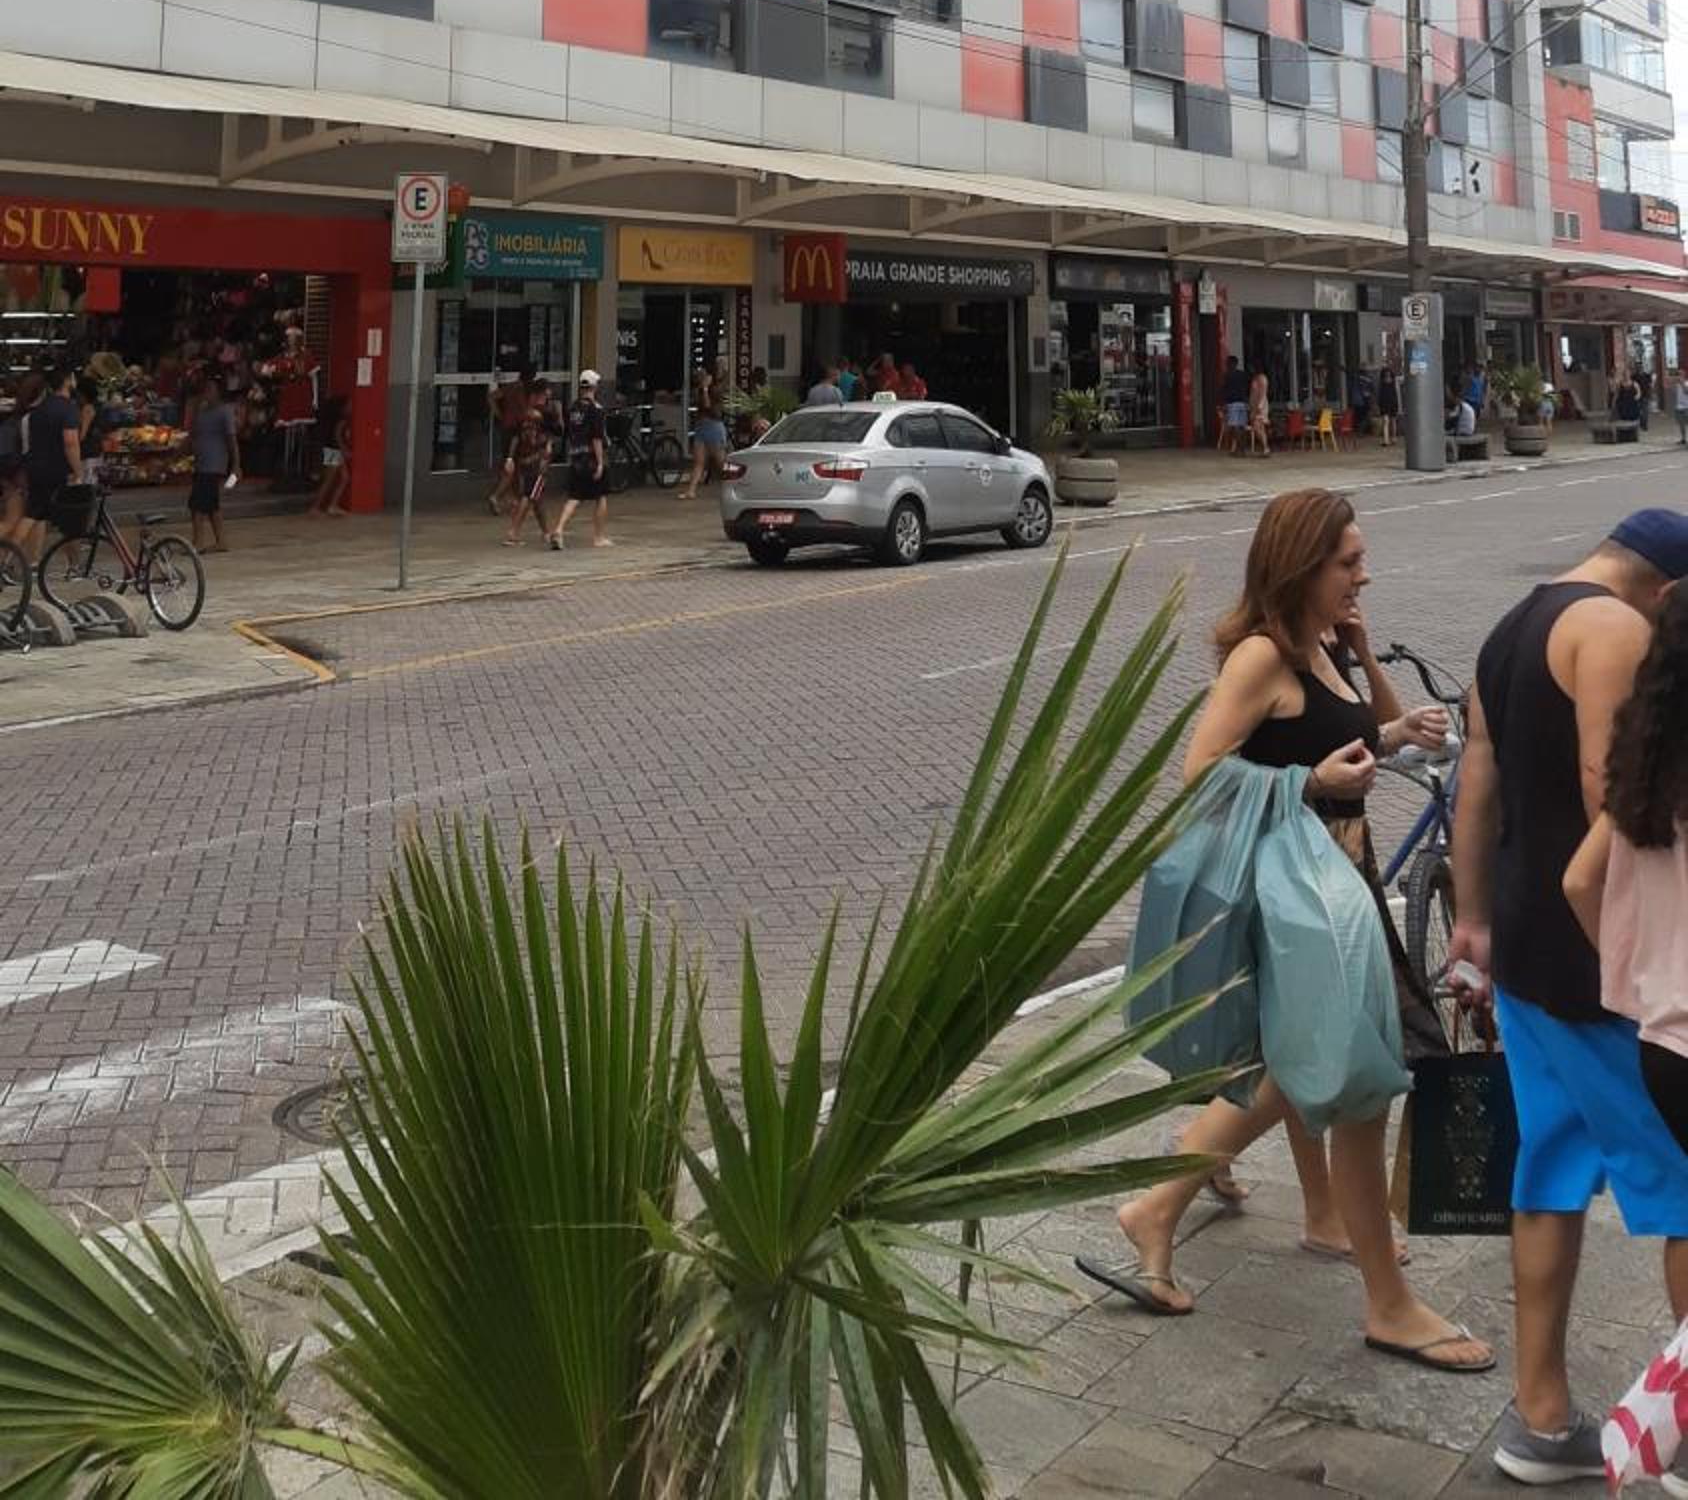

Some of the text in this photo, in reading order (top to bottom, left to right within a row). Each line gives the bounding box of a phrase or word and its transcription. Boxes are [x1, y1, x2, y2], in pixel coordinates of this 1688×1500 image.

[415, 187, 427, 210] E
[2, 204, 156, 255] SUNNY
[494, 230, 588, 255] IMOBILIÁRIA
[889, 262, 945, 284] GRANDE
[948, 265, 1012, 288] SHOPPING
[1411, 303, 1421, 317] E
